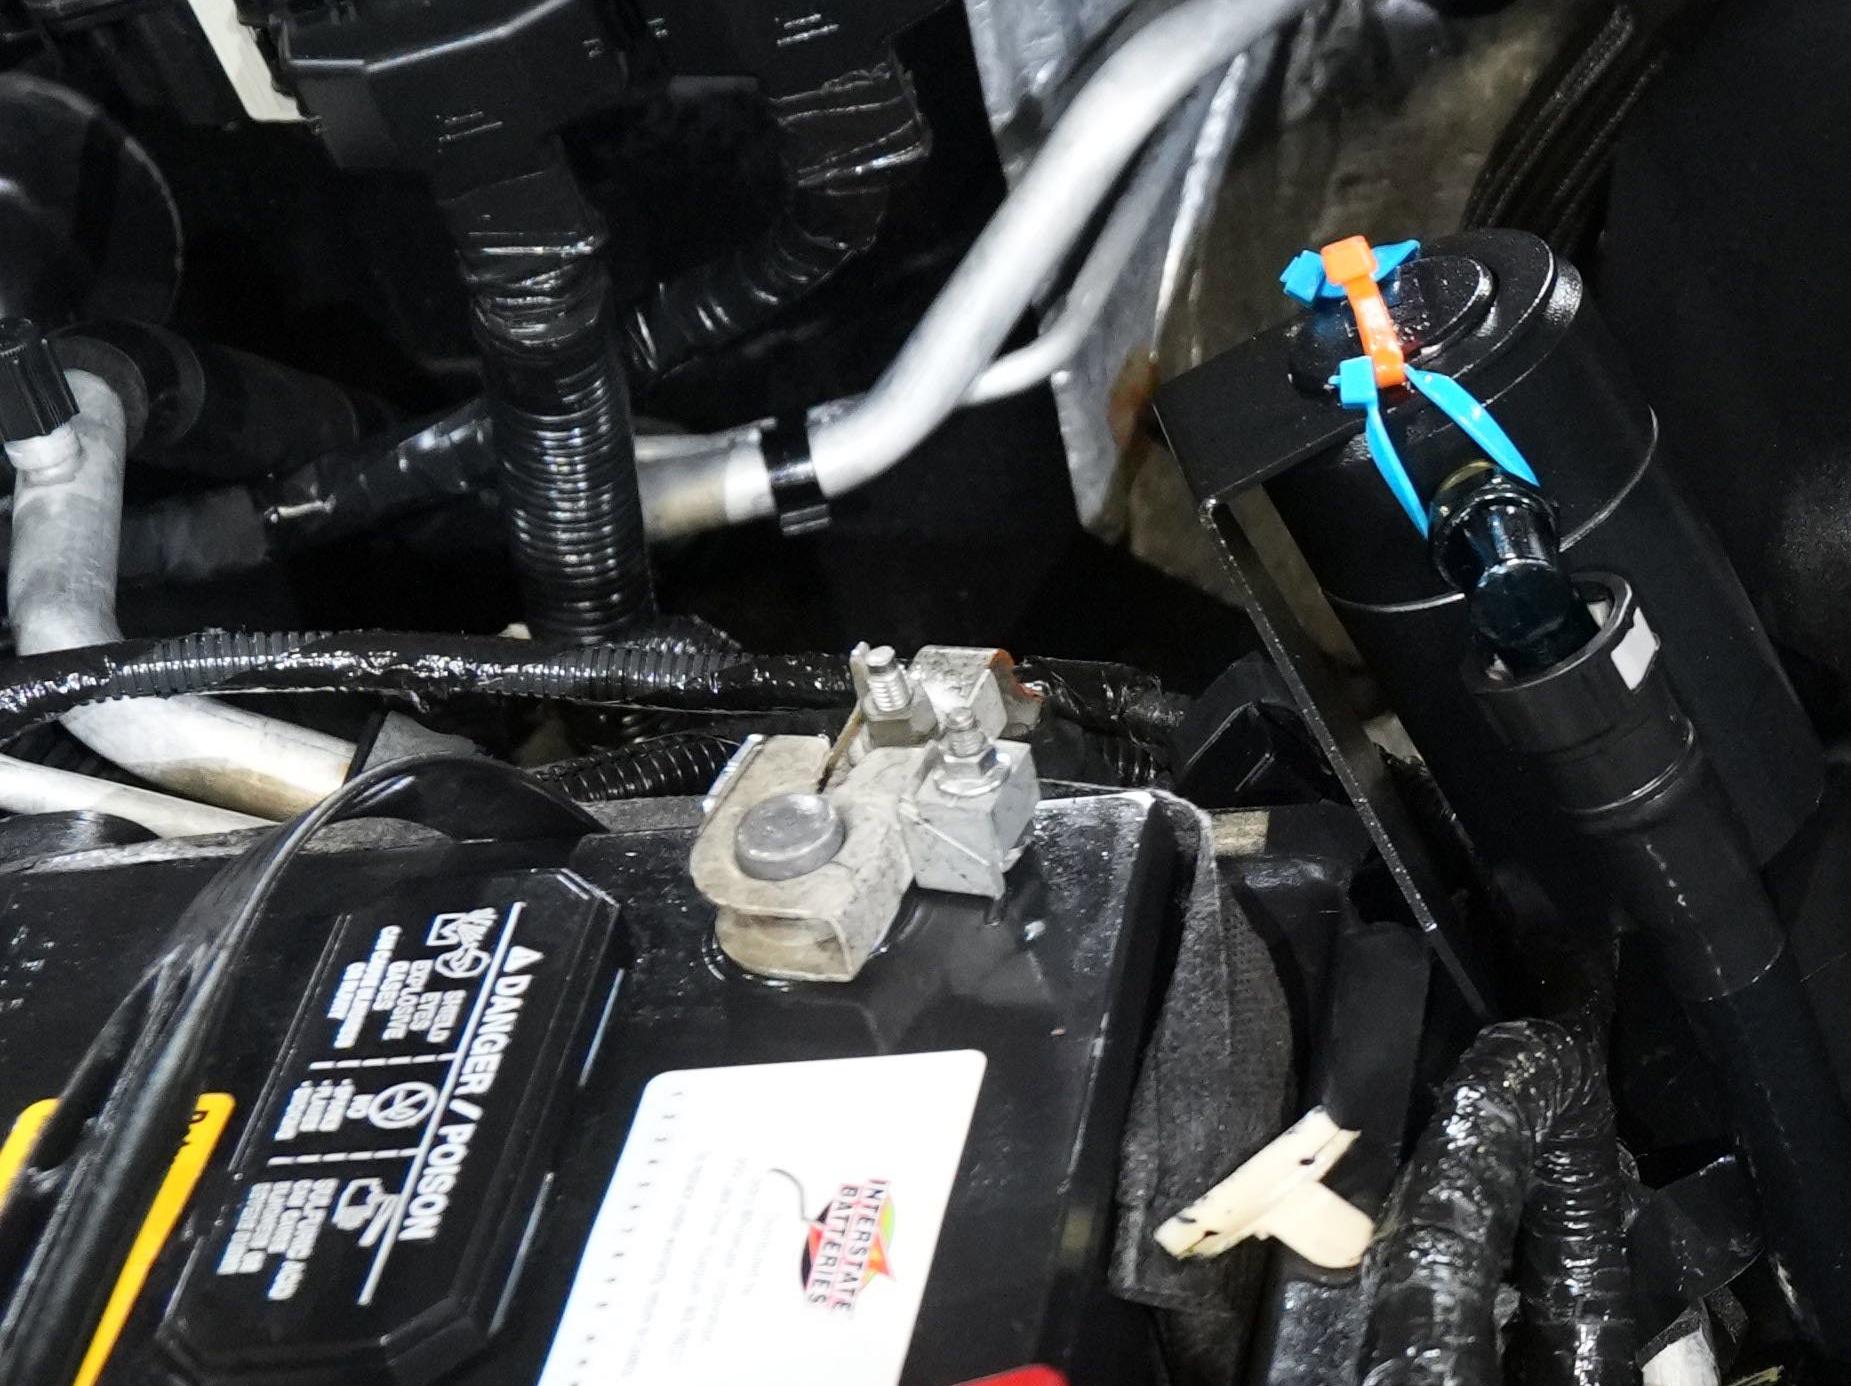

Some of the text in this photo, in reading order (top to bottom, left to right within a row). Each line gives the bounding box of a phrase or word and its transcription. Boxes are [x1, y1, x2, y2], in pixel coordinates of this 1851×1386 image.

[381, 959, 434, 1041] EXPLOSIVE
[409, 990, 443, 1031] EYES
[426, 989, 467, 1043] SHIELD
[454, 974, 533, 1096] DANGER
[397, 1123, 478, 1241] POISON
[808, 1184, 858, 1305] BATTERIES
[833, 1178, 889, 1311] INTERSTATE
